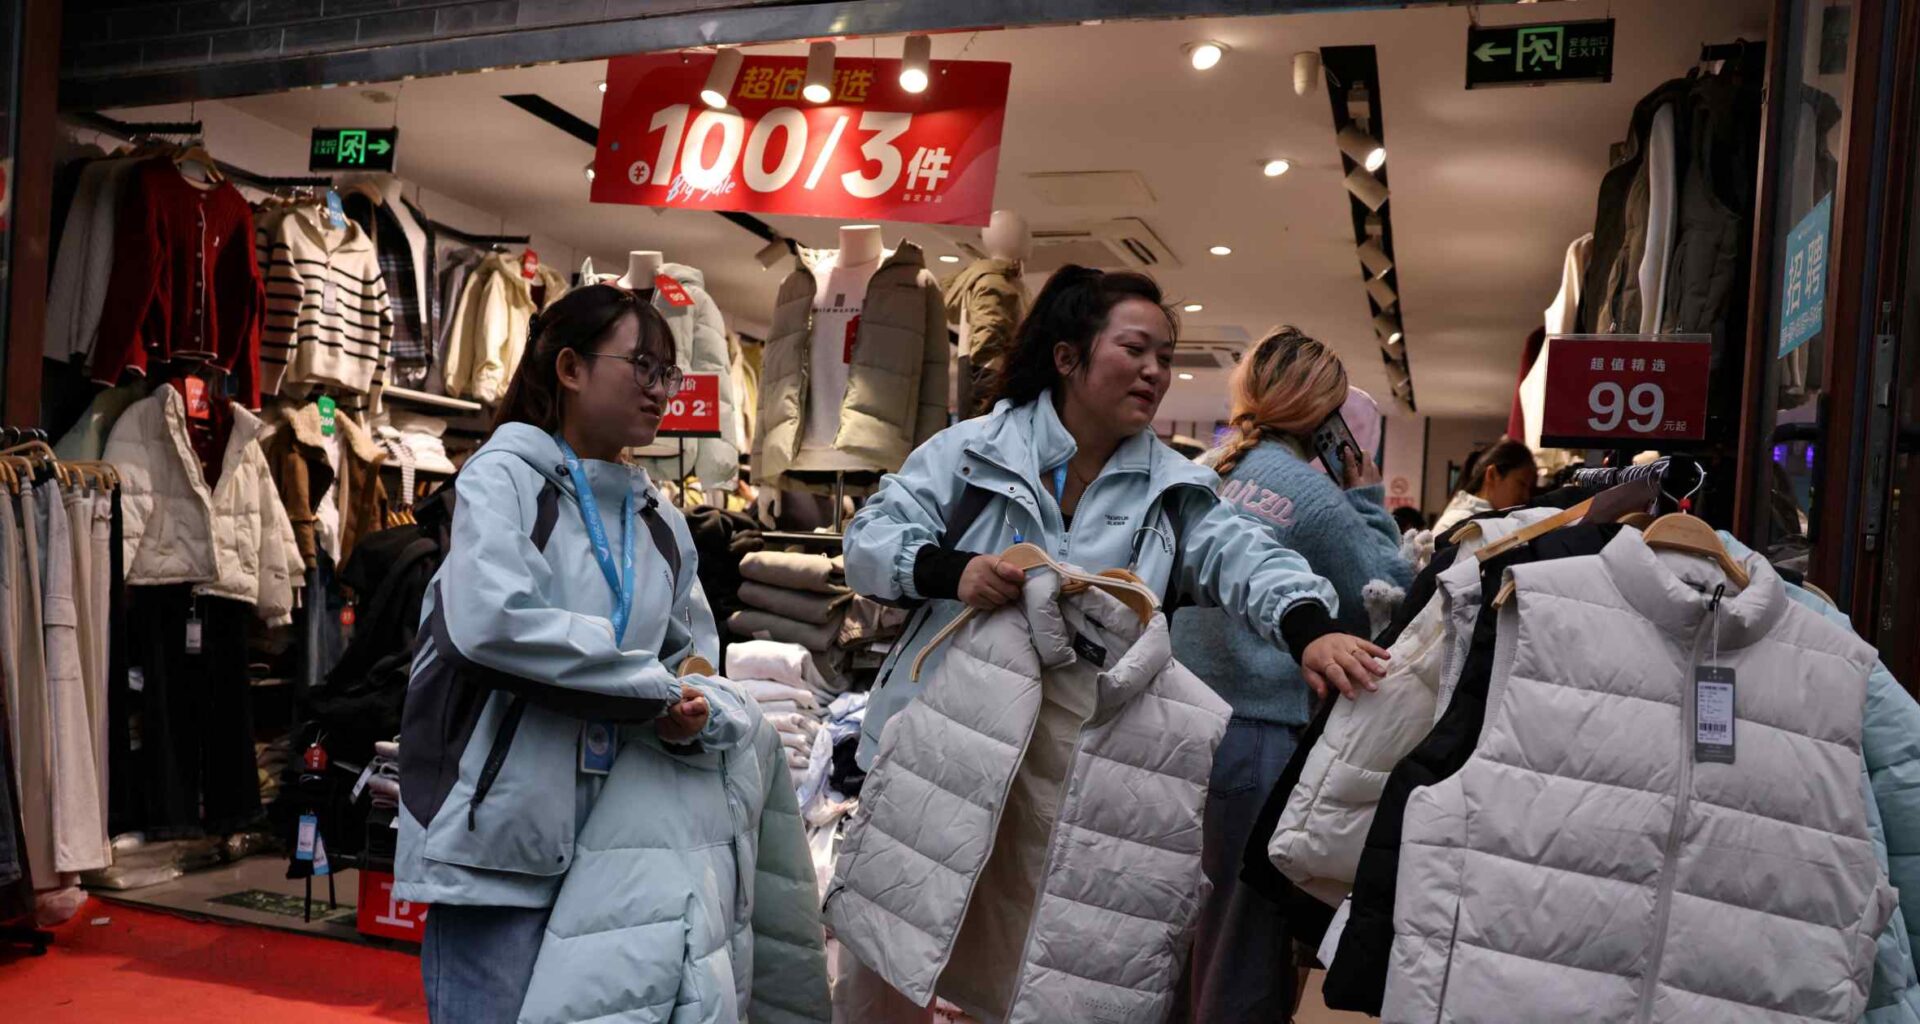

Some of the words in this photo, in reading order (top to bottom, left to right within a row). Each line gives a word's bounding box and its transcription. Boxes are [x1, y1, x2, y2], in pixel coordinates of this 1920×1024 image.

[1569, 36, 1609, 48] 安全出口
[1568, 46, 1608, 59] EXIT
[1787, 231, 1824, 318] 招聘
[1590, 356, 1668, 373] 超值精选
